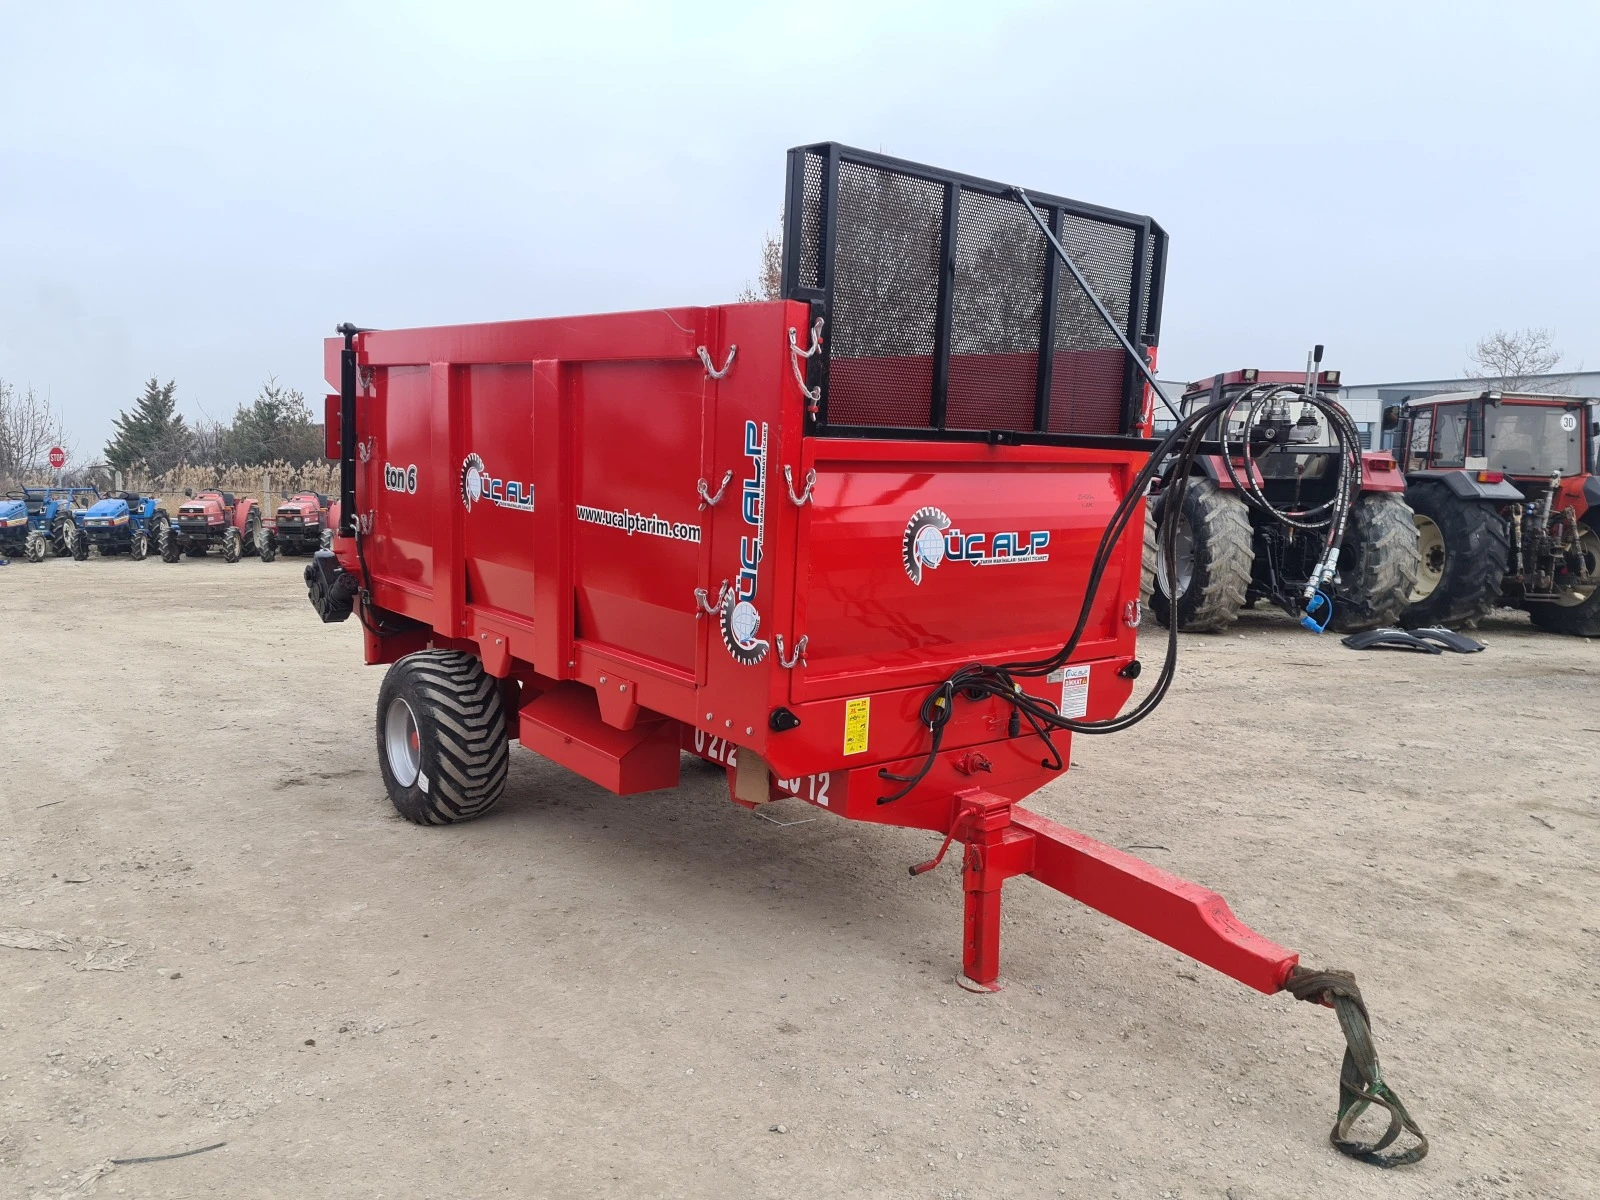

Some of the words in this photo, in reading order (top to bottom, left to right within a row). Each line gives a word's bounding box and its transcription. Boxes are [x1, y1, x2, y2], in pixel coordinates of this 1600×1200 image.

[1563, 417, 1574, 428] 30
[50, 453, 64, 462] STOP
[742, 420, 762, 526] ALP
[385, 463, 405, 492] ton
[407, 464, 417, 494] 6
[576, 505, 701, 542] www.ucalptarim.com
[992, 531, 1050, 558] ALP
[808, 772, 830, 807] 12
